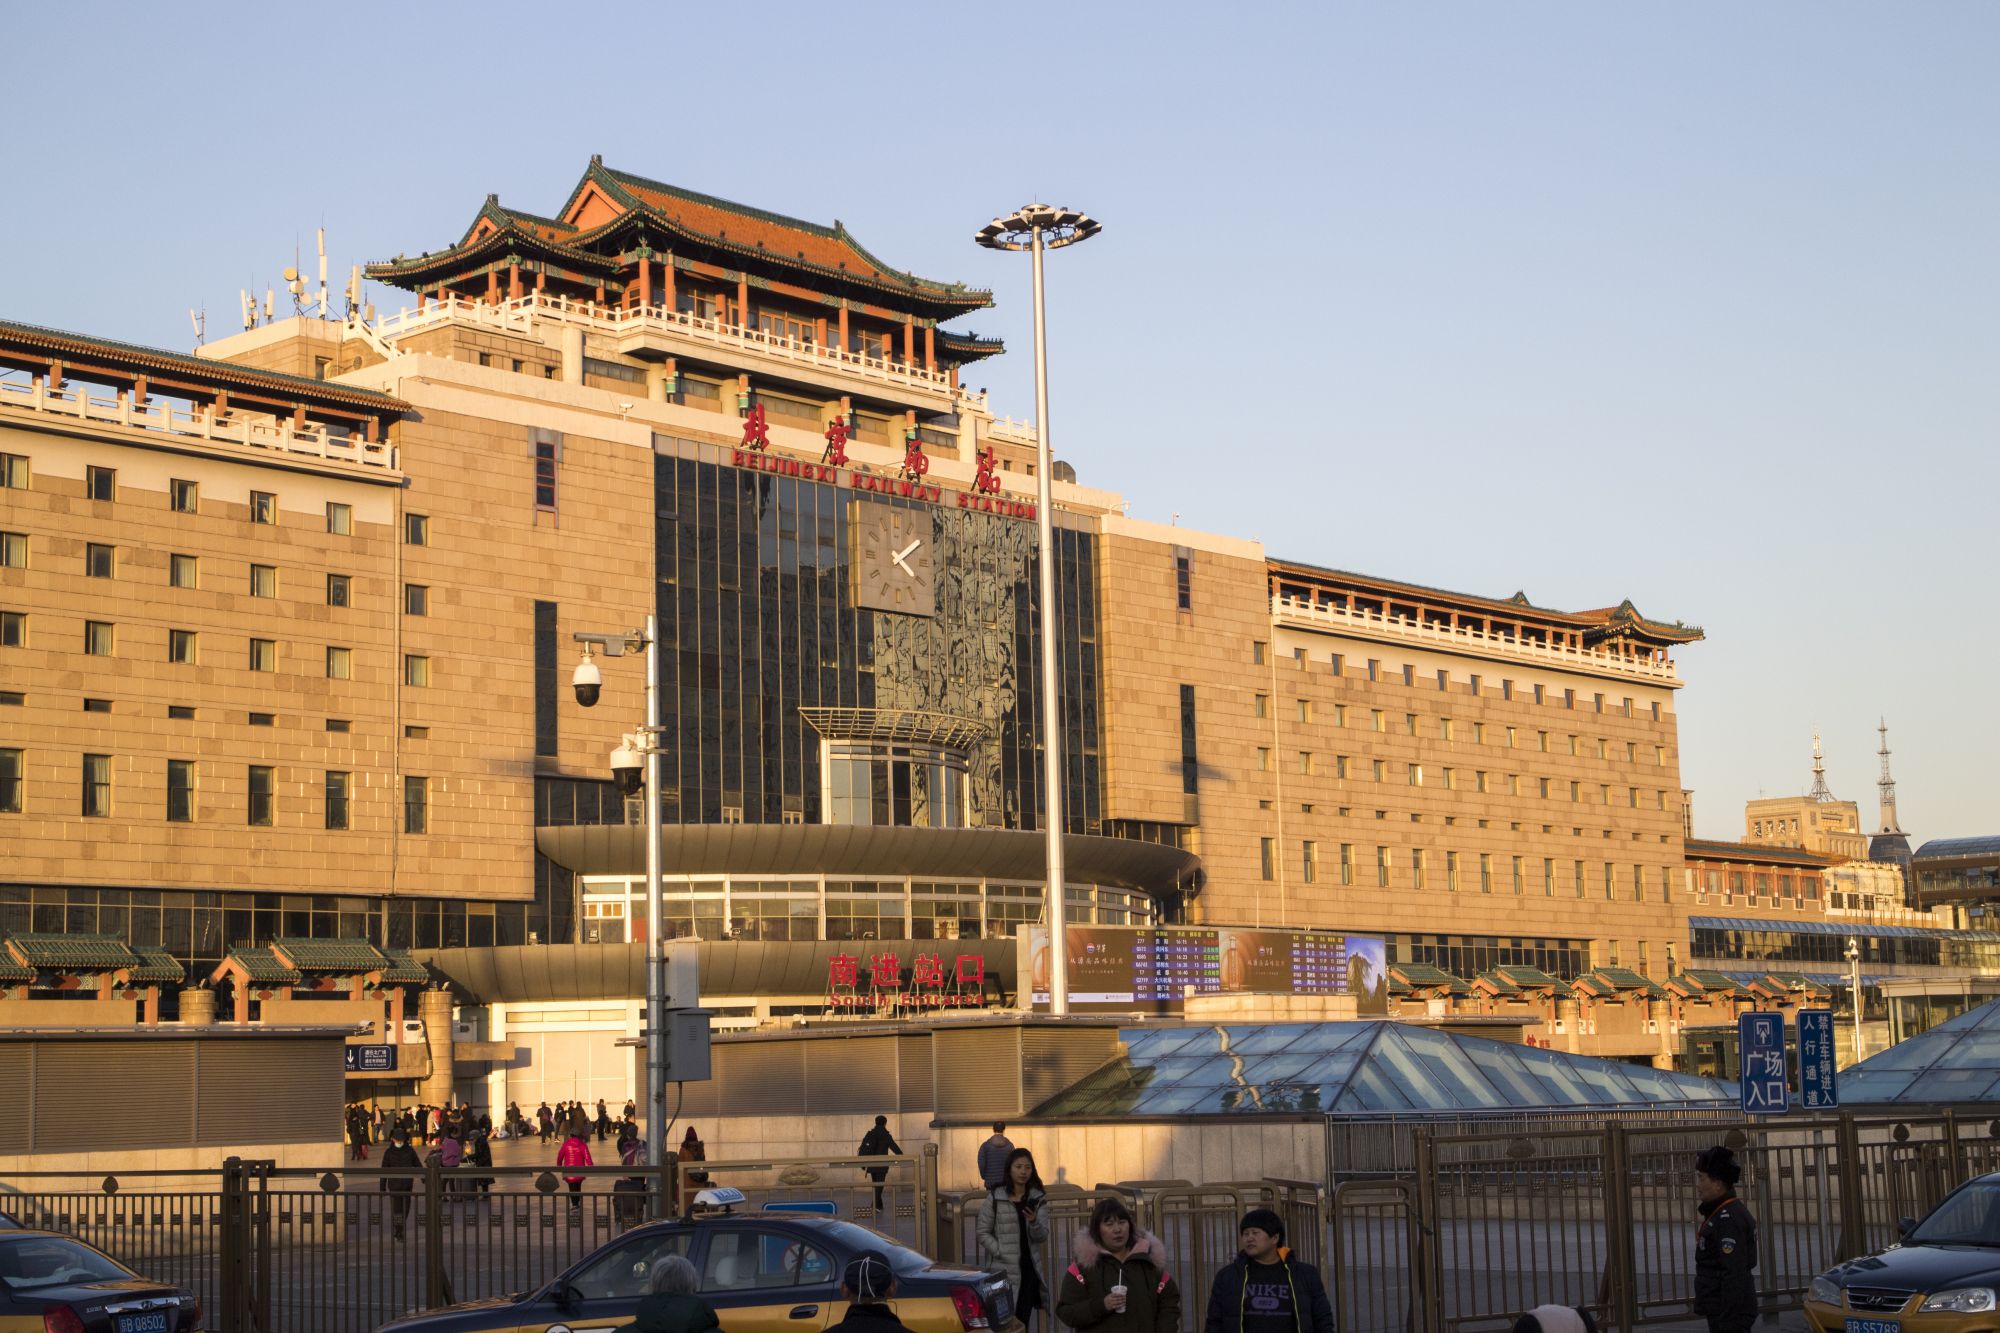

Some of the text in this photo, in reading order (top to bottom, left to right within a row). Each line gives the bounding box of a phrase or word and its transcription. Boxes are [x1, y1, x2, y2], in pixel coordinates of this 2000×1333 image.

[731, 449, 1036, 520] BEIJINGXI RAILWAY STATION
[829, 952, 984, 987] 南进站口
[830, 992, 984, 1008] South Entrance
[1746, 1050, 1782, 1077] 广场
[1804, 1016, 1819, 1105] 人行通道
[1818, 1015, 1833, 1104] 禁止车辆进入
[1747, 1081, 1784, 1106] 入口
[1245, 1283, 1290, 1299] NIKE
